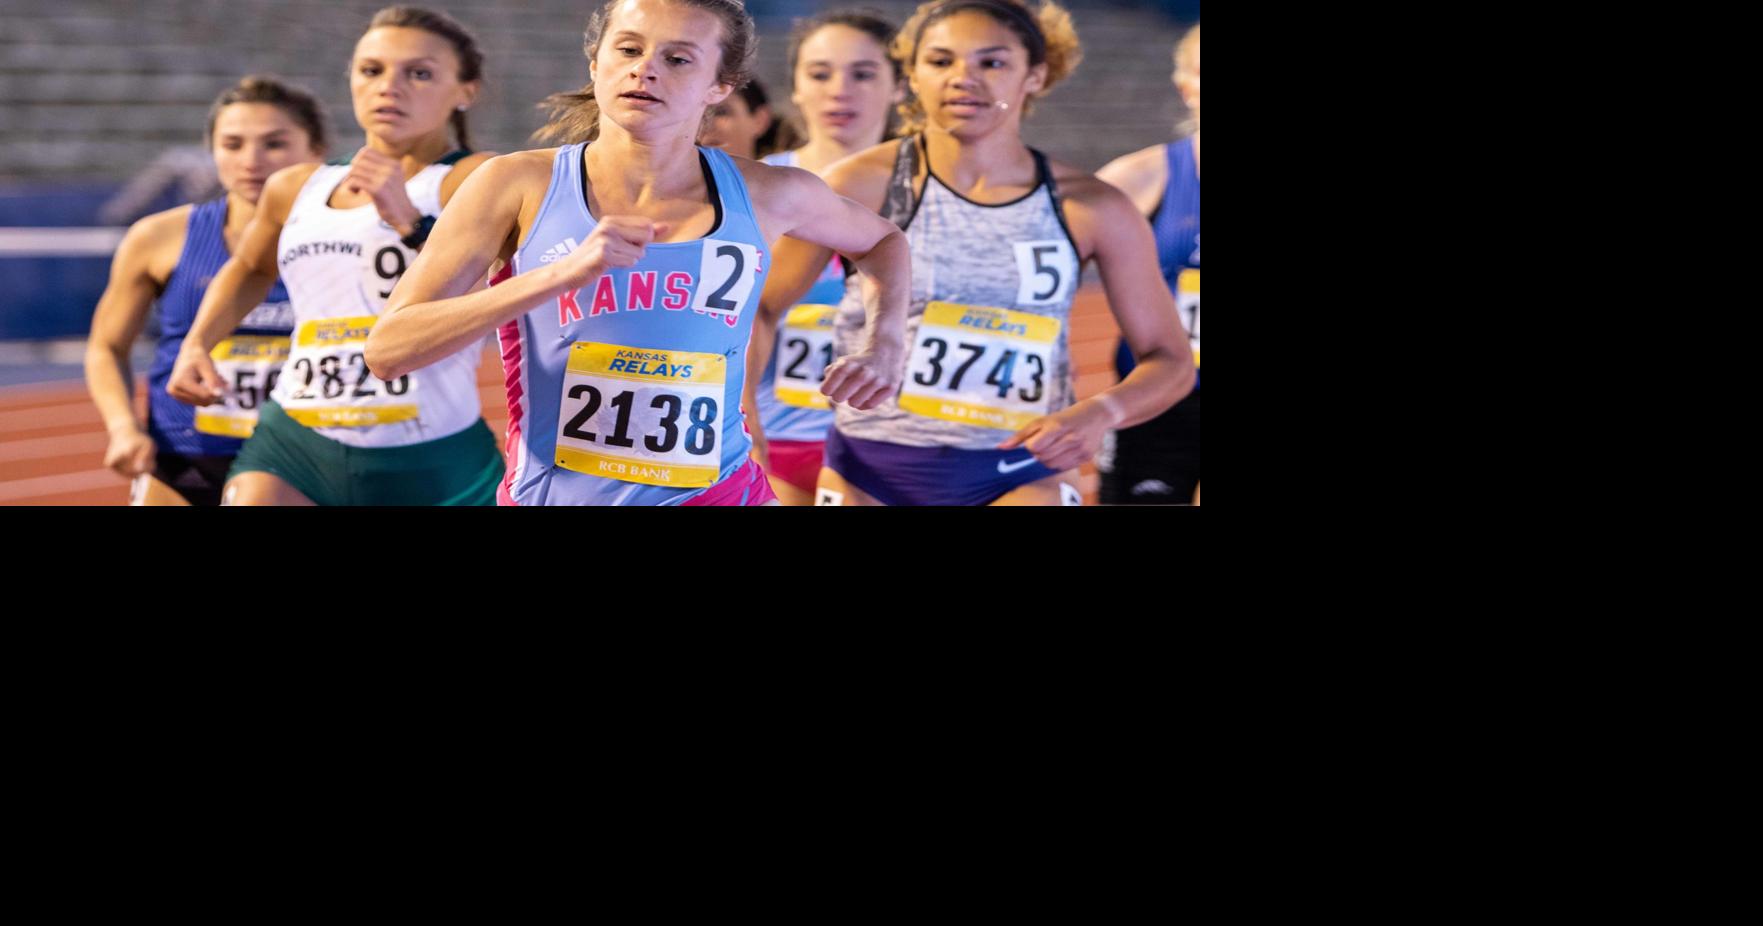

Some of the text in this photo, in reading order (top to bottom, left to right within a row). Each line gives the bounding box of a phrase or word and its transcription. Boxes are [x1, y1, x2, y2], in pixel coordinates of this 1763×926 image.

[282, 241, 363, 266] ORTHW
[375, 246, 406, 299] 9
[704, 244, 744, 311] 2
[1031, 245, 1060, 301] 5
[557, 271, 738, 328] KANS
[608, 358, 693, 378] RELAYS
[616, 349, 668, 362] KANSAS
[914, 337, 1044, 403] 3743
[563, 384, 718, 456] 2138
[599, 460, 671, 482] RCB BANK
